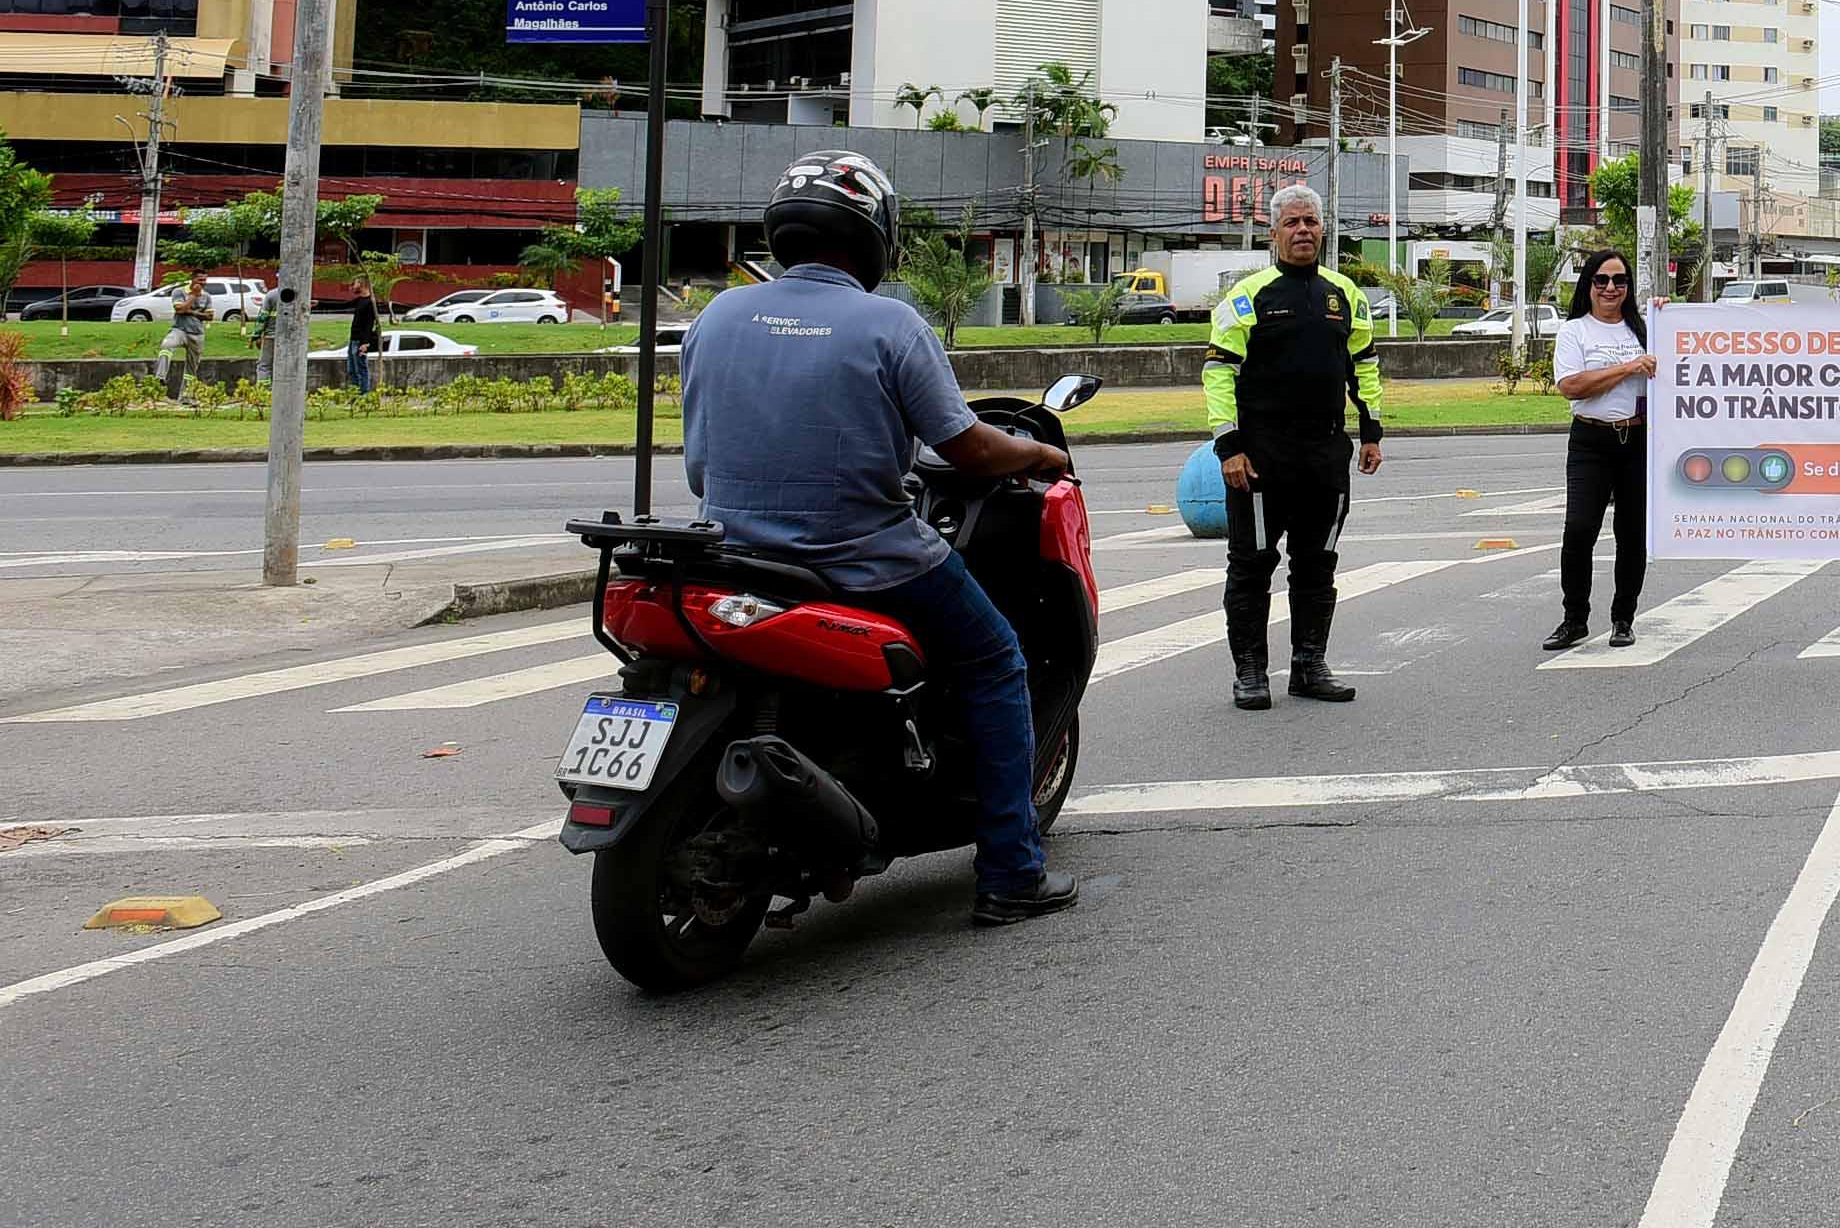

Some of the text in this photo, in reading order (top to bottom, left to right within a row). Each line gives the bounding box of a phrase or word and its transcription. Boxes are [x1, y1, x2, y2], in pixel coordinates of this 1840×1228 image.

[515, 0, 608, 11] Antônio Carlos
[513, 17, 579, 30] Magalhães
[769, 325, 833, 336] ELEVADORES
[1675, 331, 1802, 355] EXCESSO
[1675, 357, 1691, 387] É
[1696, 363, 1716, 387] A
[1721, 363, 1814, 387] MAIOR
[1675, 395, 1718, 419] NO
[1803, 461, 1824, 476] Se
[1673, 514, 1724, 523] SEMANA
[1729, 514, 1793, 524] NACIONAL
[1798, 515, 1815, 524] DO
[1674, 528, 1682, 539] A
[1687, 528, 1712, 539] PAZ
[1716, 528, 1736, 539] NO
[1740, 526, 1805, 539] TRÂNSITO
[612, 705, 648, 718] BRASIL
[591, 717, 652, 749] SJJ
[568, 746, 646, 781] 1C66
